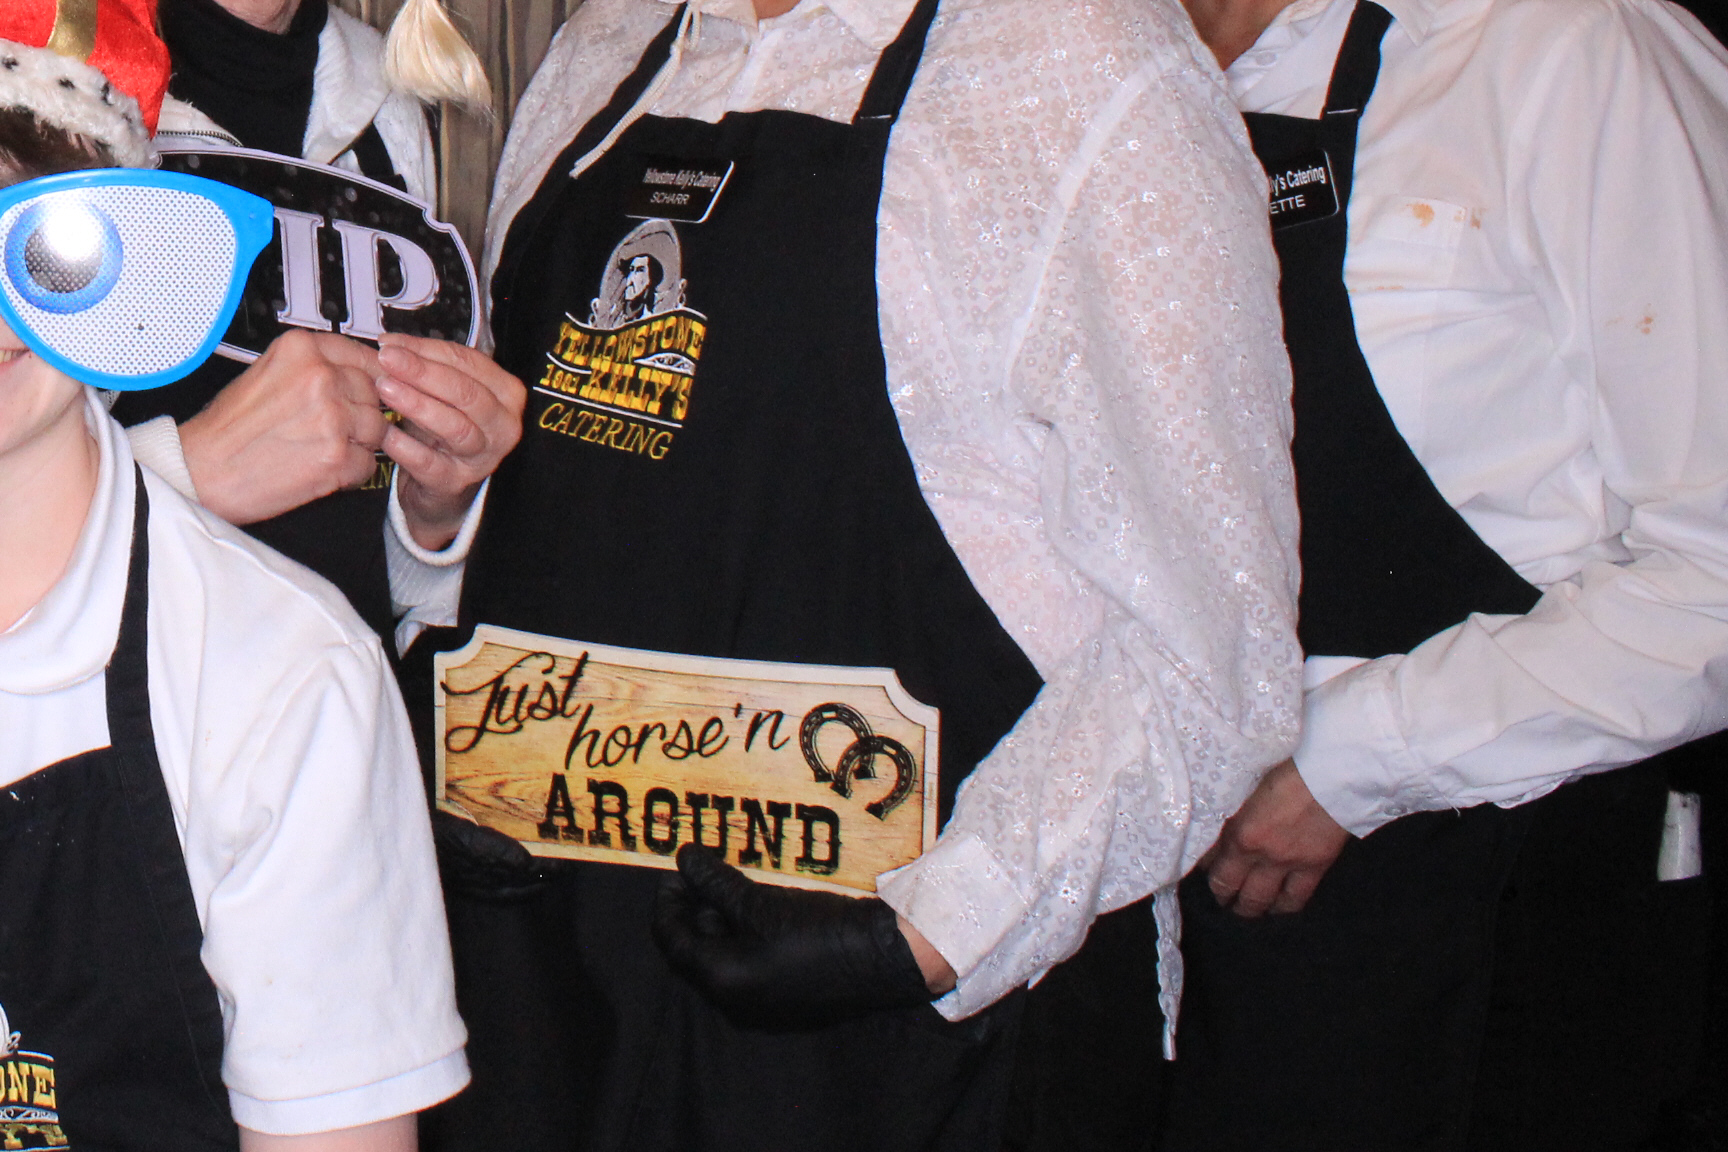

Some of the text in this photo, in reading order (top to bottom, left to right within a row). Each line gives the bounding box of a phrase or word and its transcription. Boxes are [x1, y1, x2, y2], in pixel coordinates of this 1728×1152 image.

[1269, 194, 1307, 215] ETTE
[1286, 164, 1327, 188] Catering
[273, 205, 441, 341] IP
[552, 315, 707, 367] YELLOWSTONE
[578, 357, 694, 421] KELLY'S
[538, 402, 675, 460] CATERING
[439, 650, 590, 755] Just
[564, 702, 791, 771] horse'n
[537, 772, 844, 876] AROUND
